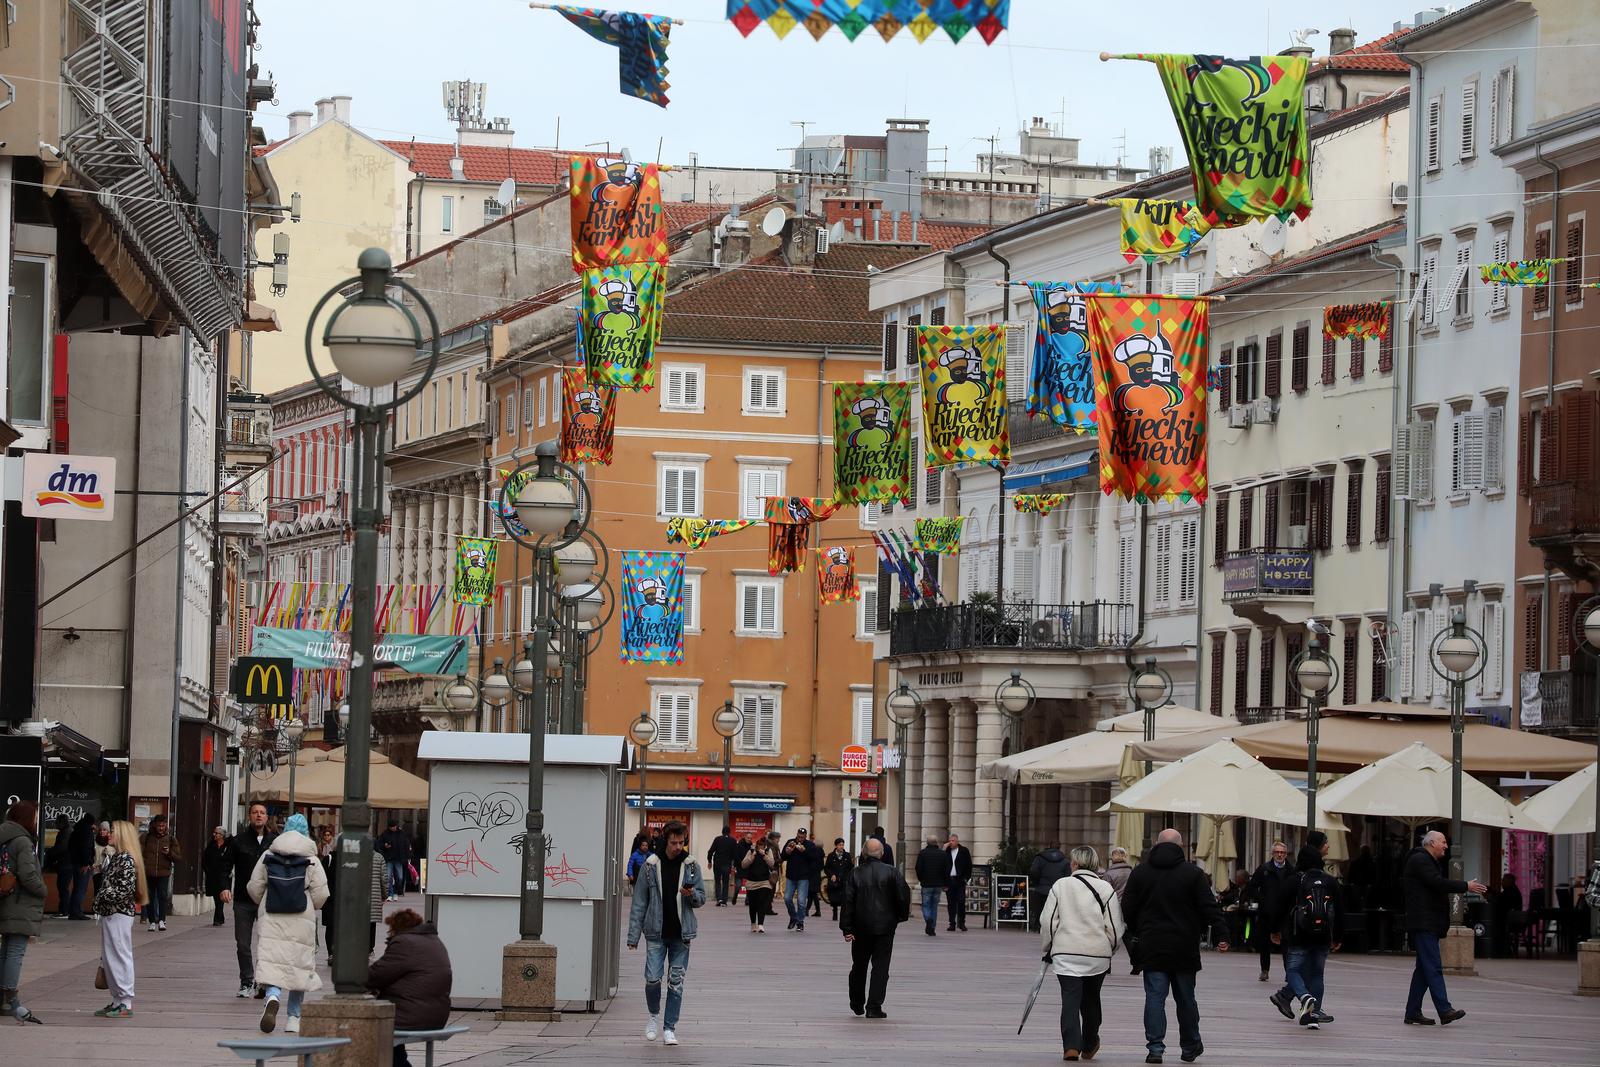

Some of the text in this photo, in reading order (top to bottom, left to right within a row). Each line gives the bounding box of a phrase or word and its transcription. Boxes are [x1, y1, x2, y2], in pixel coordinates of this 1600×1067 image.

[933, 400, 998, 431] Riječki
[844, 445, 902, 471] Riječki
[48, 463, 97, 493] dm
[1266, 557, 1310, 567] HAPPY
[373, 644, 416, 662] ORTE!
[919, 671, 963, 685] RADIO RIJEKA
[842, 760, 867, 768] KING
